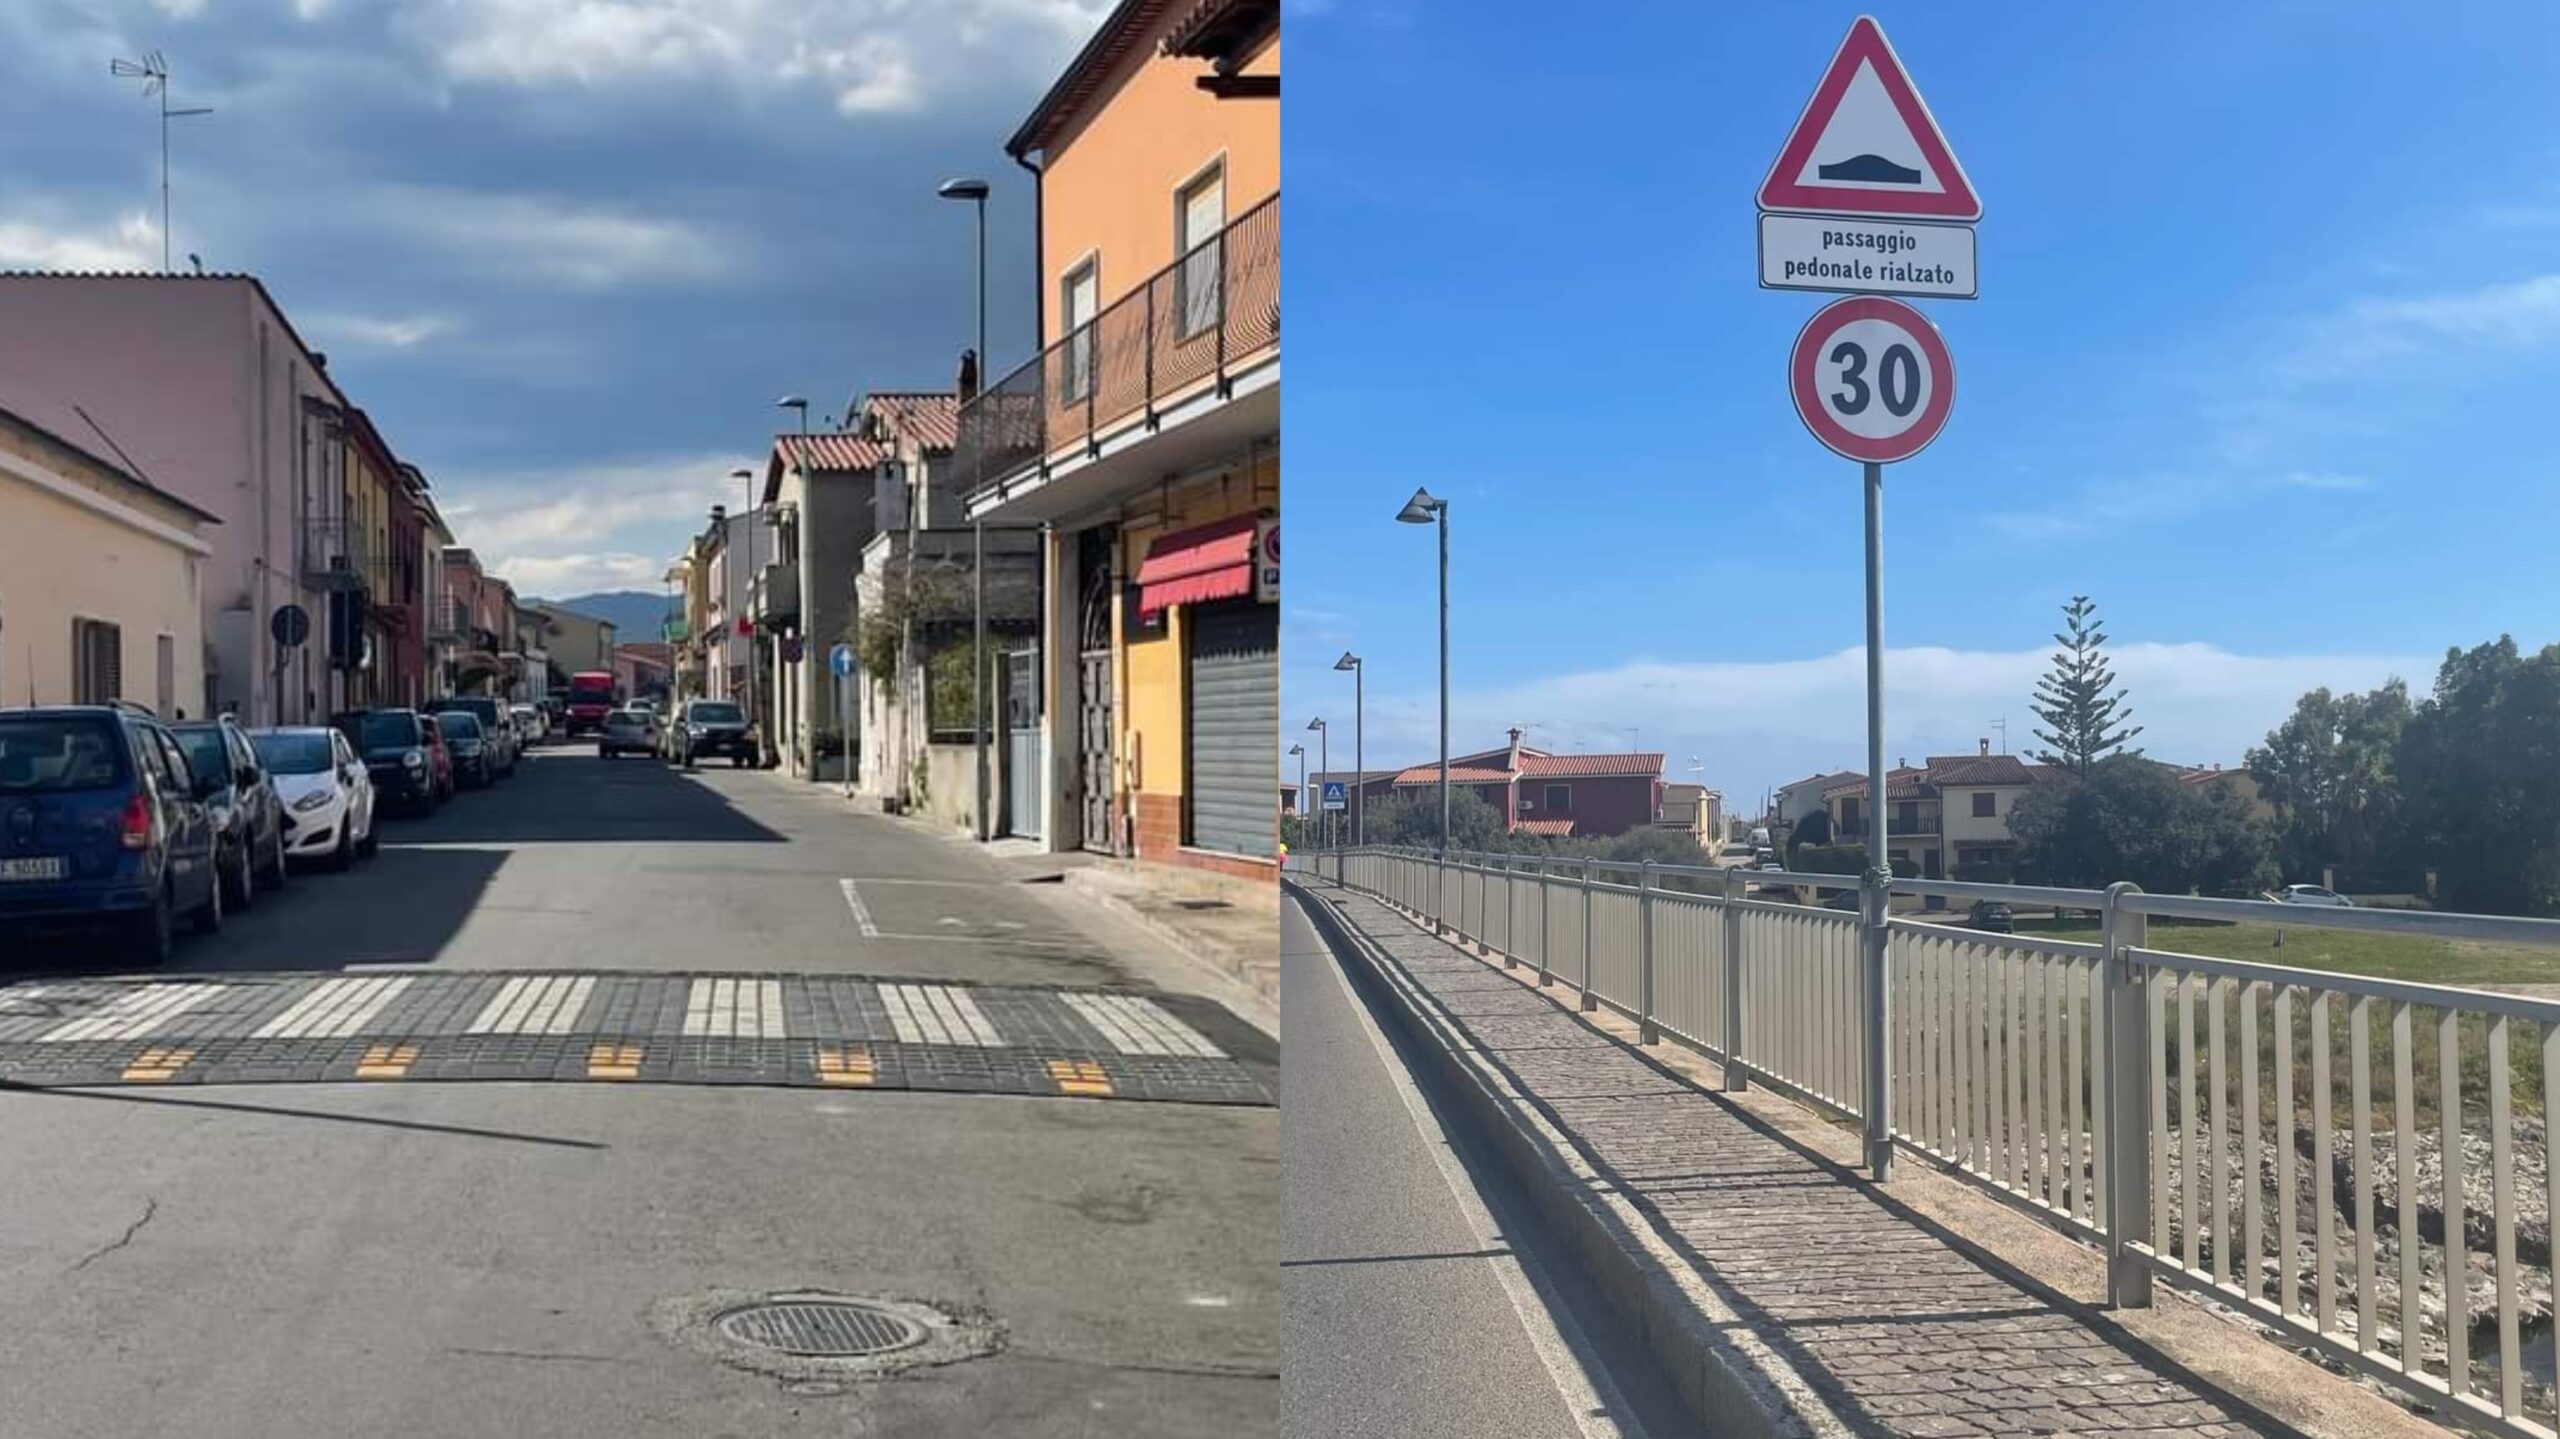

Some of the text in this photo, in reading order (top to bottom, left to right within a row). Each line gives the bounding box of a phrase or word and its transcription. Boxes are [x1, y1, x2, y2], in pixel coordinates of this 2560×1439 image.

[1823, 230, 1916, 254] passaggio
[1785, 257, 1954, 284] pedonale rialzato
[1830, 341, 1921, 417] 30
